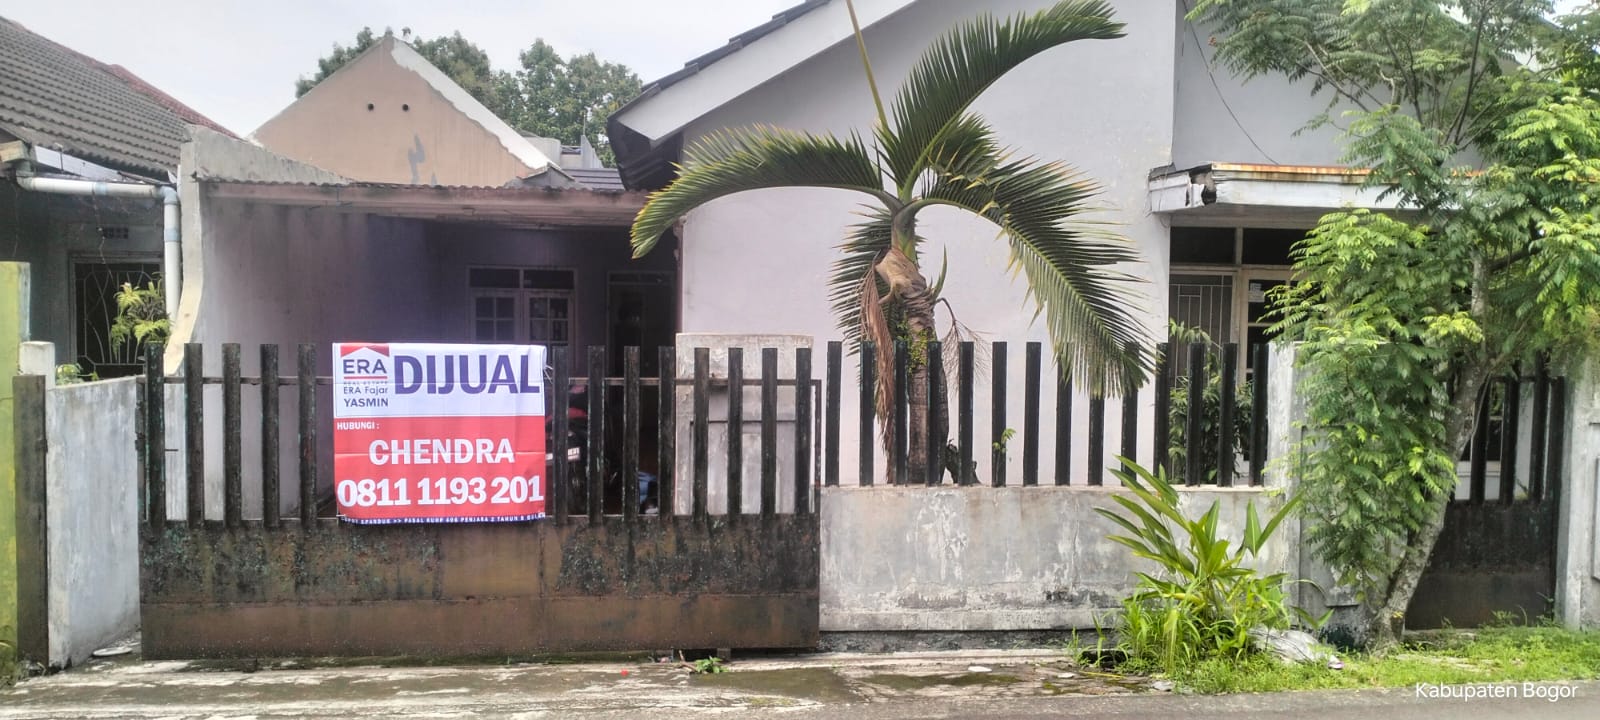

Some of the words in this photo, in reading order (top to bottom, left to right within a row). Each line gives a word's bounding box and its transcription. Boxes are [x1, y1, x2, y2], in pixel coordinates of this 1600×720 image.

[343, 359, 387, 374] ERA
[394, 355, 540, 394] DIJUAL
[343, 386, 361, 394] ERA
[364, 386, 388, 396] Fajar
[343, 398, 389, 407] YASMIN
[336, 421, 375, 430] HUBUNGI
[368, 438, 515, 465] CHENDRA
[336, 478, 411, 508] 0811
[417, 477, 487, 505] 1193
[490, 475, 544, 504] 201
